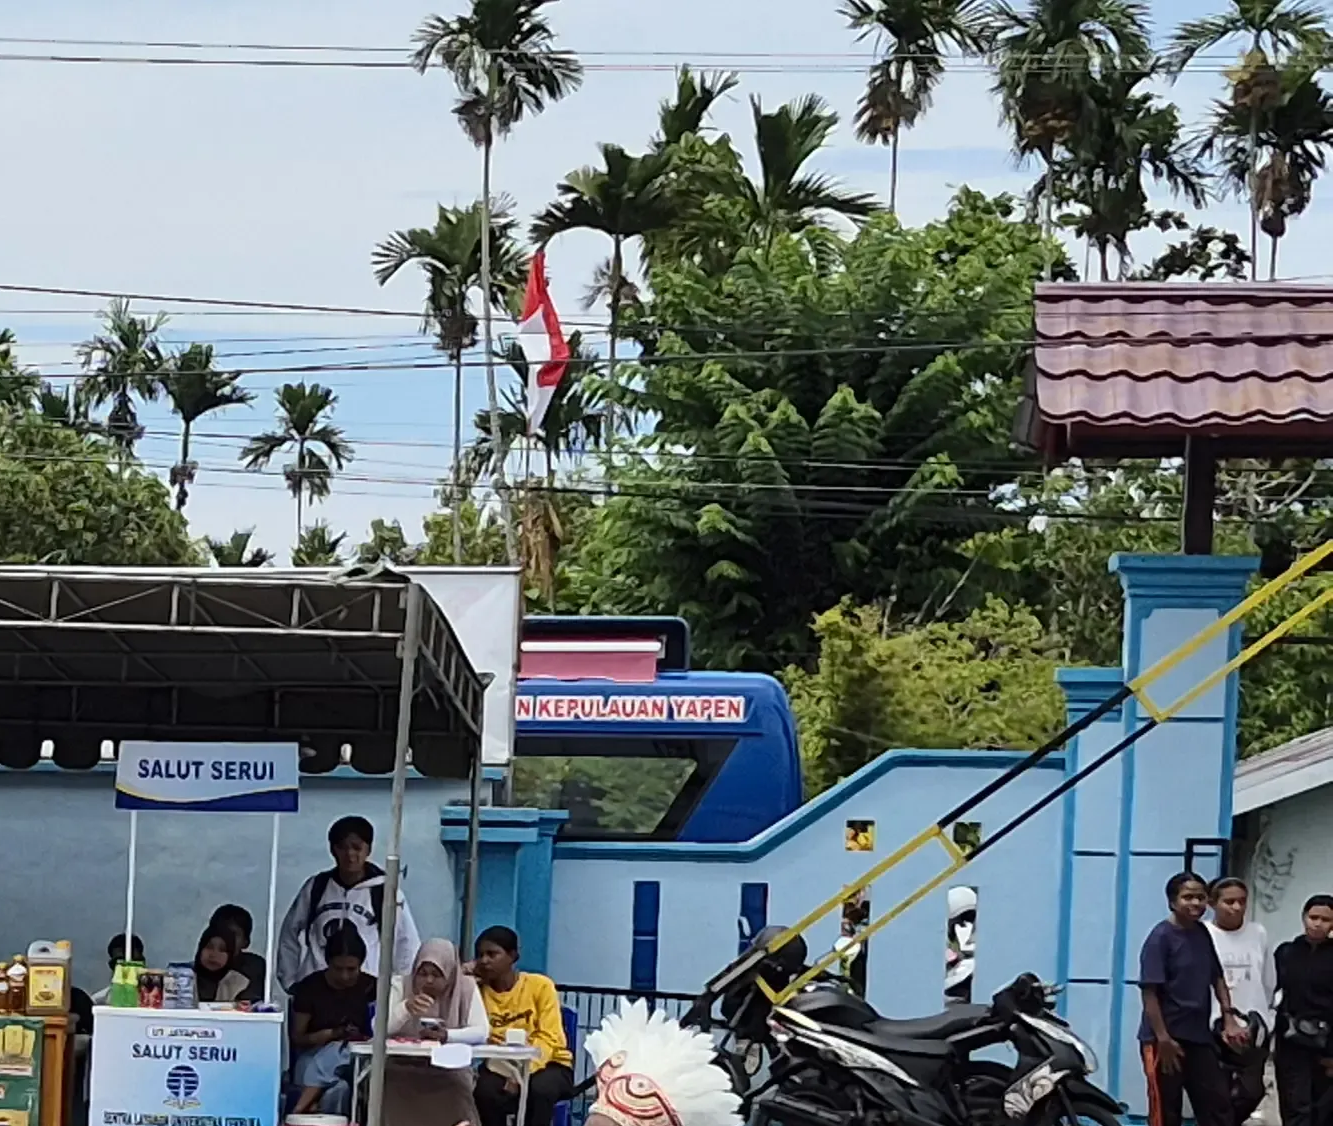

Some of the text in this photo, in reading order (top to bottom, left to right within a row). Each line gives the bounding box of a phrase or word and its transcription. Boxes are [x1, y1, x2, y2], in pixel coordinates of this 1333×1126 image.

[537, 697, 666, 720] KEPULAUAN
[672, 698, 743, 720] YAPEN
[136, 758, 275, 781] SALUT SERUI
[132, 1043, 238, 1062] SALUT SERUI
